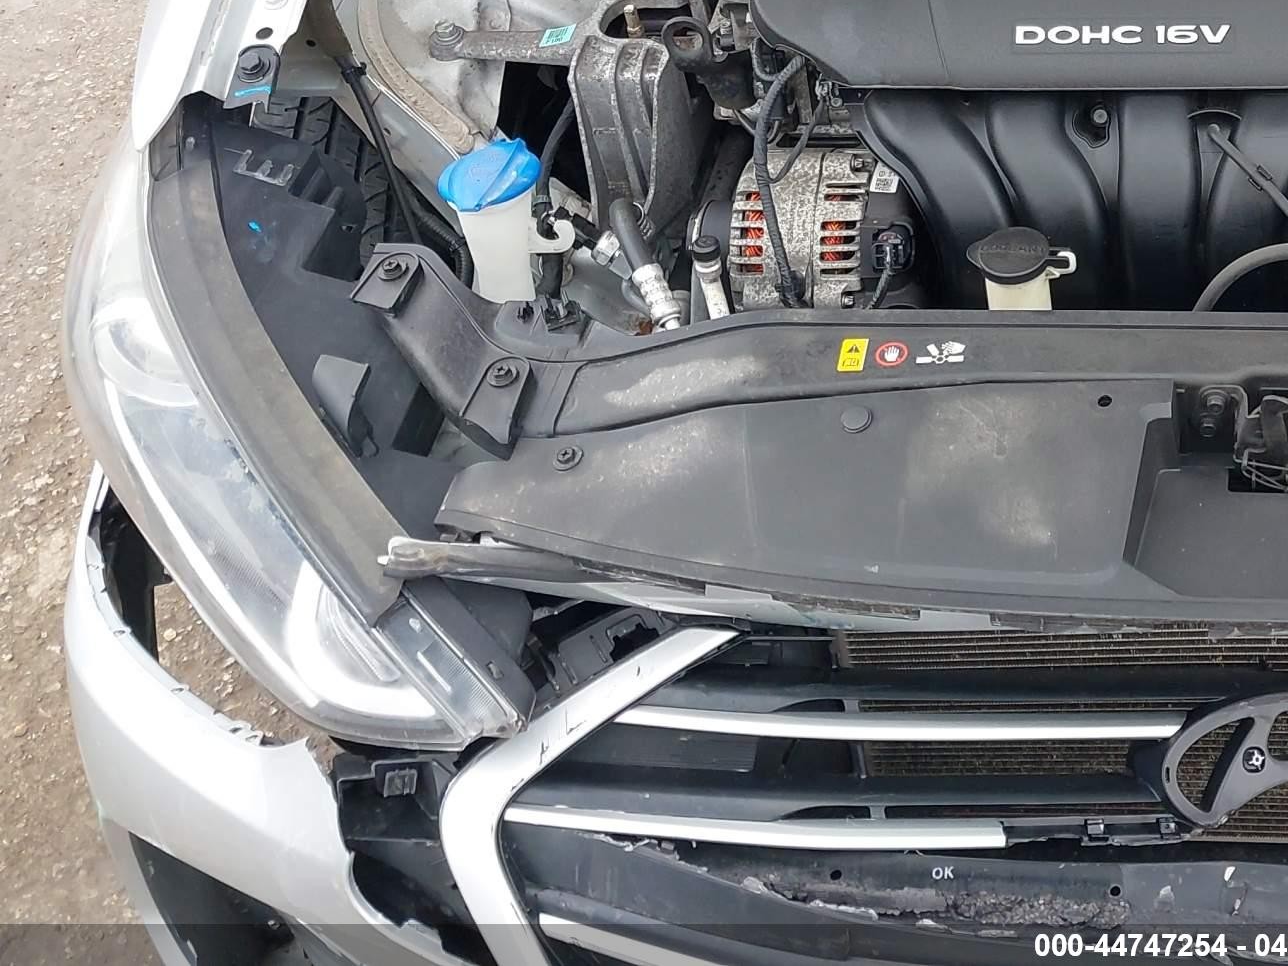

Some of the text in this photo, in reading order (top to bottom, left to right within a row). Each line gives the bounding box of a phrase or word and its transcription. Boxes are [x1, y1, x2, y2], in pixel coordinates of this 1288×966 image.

[1015, 24, 1231, 44] DOHC 16V
[932, 866, 954, 880] OK
